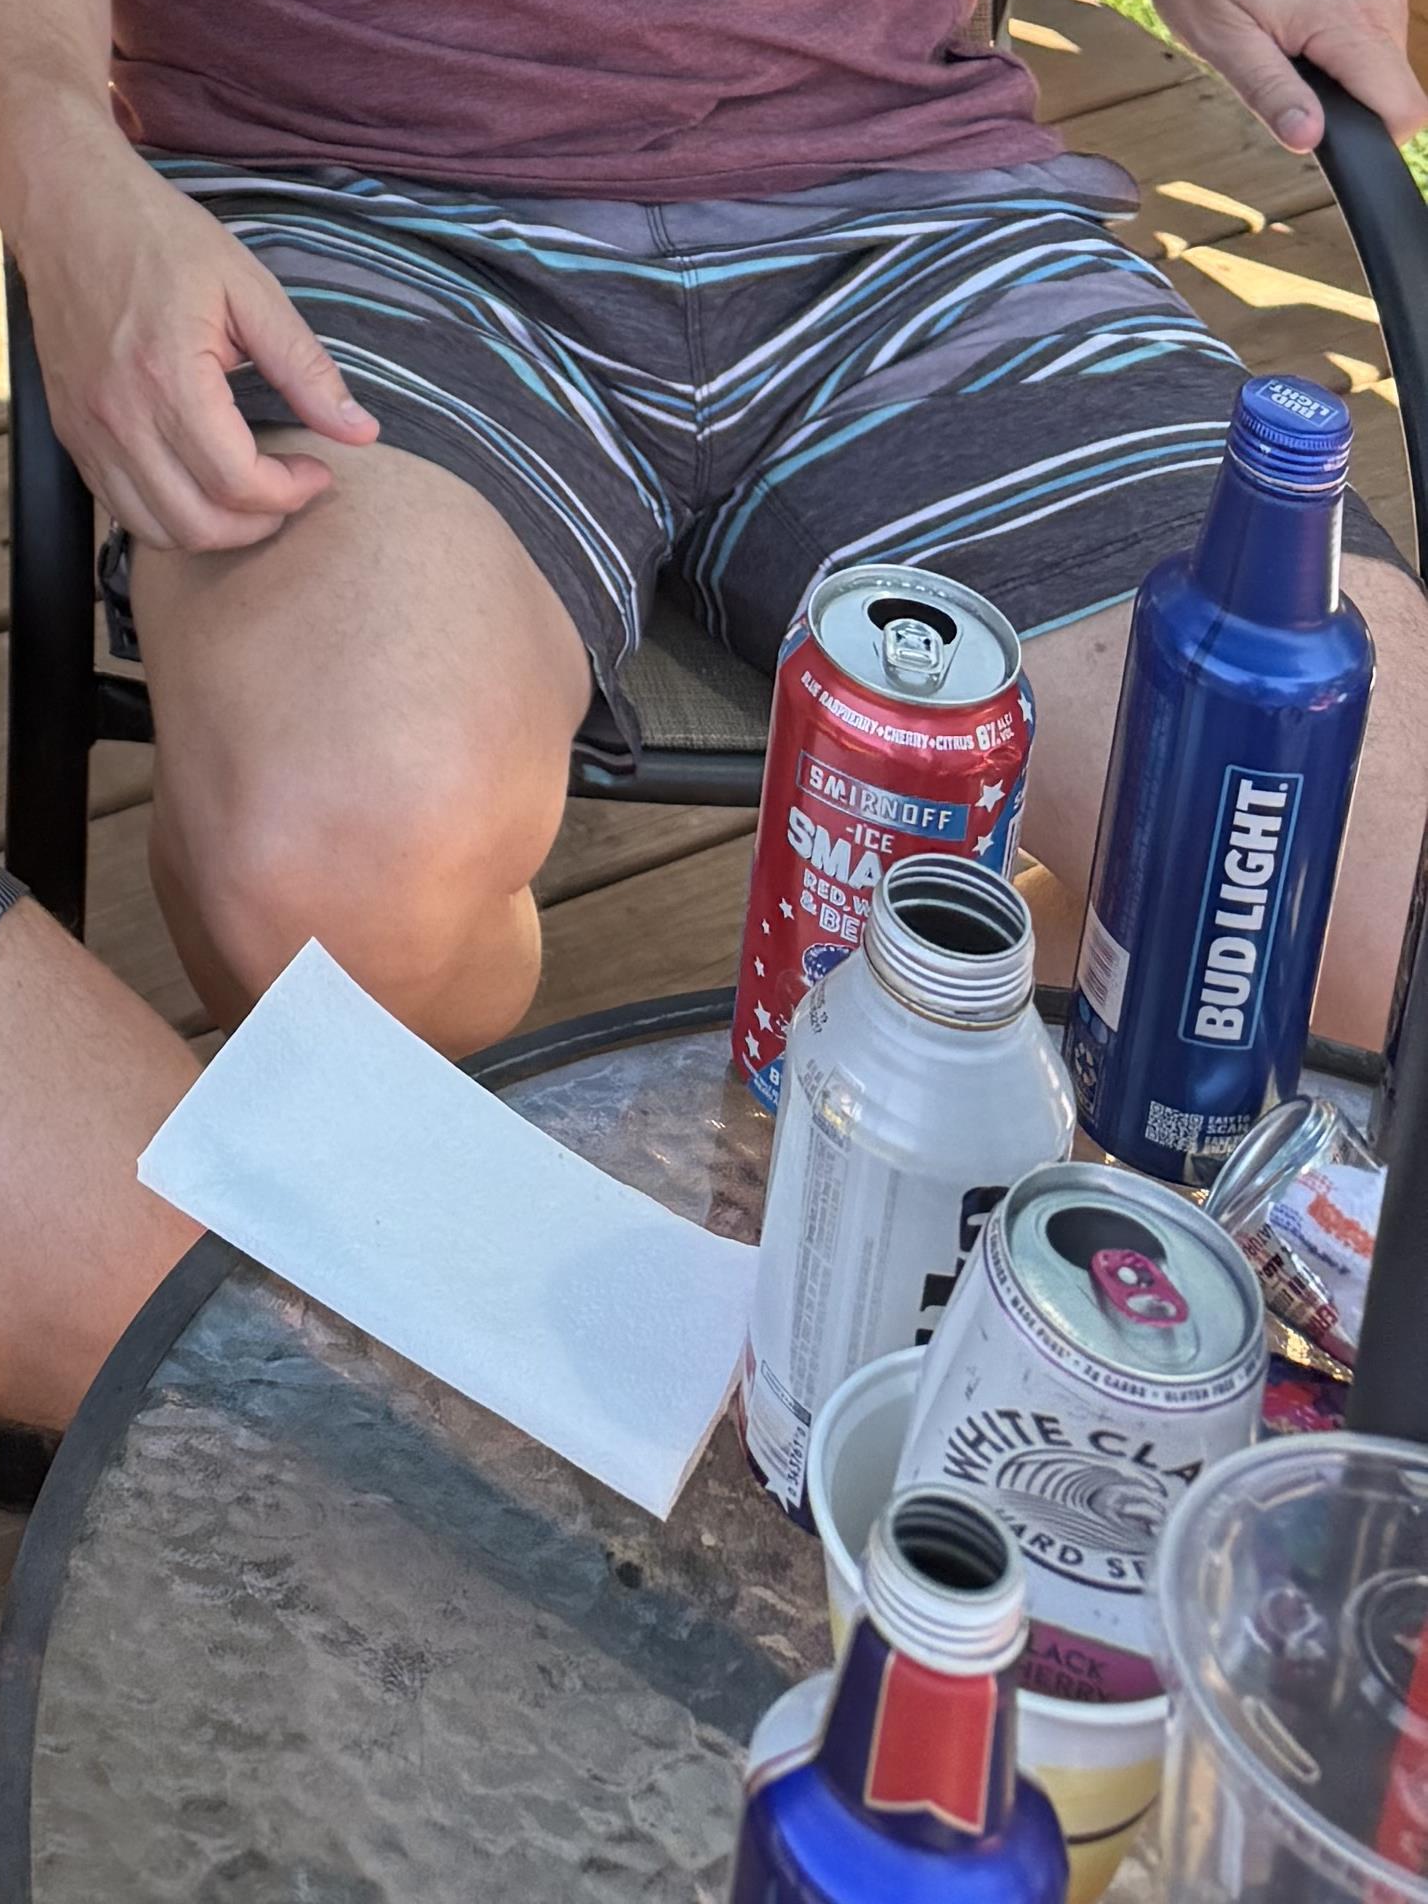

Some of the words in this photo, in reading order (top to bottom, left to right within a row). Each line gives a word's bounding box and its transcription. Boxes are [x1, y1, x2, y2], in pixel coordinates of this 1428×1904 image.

[1269, 383, 1330, 416] LIGHT
[1271, 393, 1315, 419] BUD
[801, 671, 822, 698] BLUE
[819, 691, 878, 735] RASPBERRY
[883, 725, 929, 749] CHERRY
[936, 735, 973, 750] CITRUS
[809, 765, 952, 830] SMIRNOFF
[787, 807, 883, 889] SMA
[800, 890, 817, 915] &
[1194, 936, 1257, 1040] BUD
[943, 1409, 1073, 1485] WHITE
[1088, 1430, 1203, 1486] CLA
[1026, 1635, 1107, 1681] LACK
